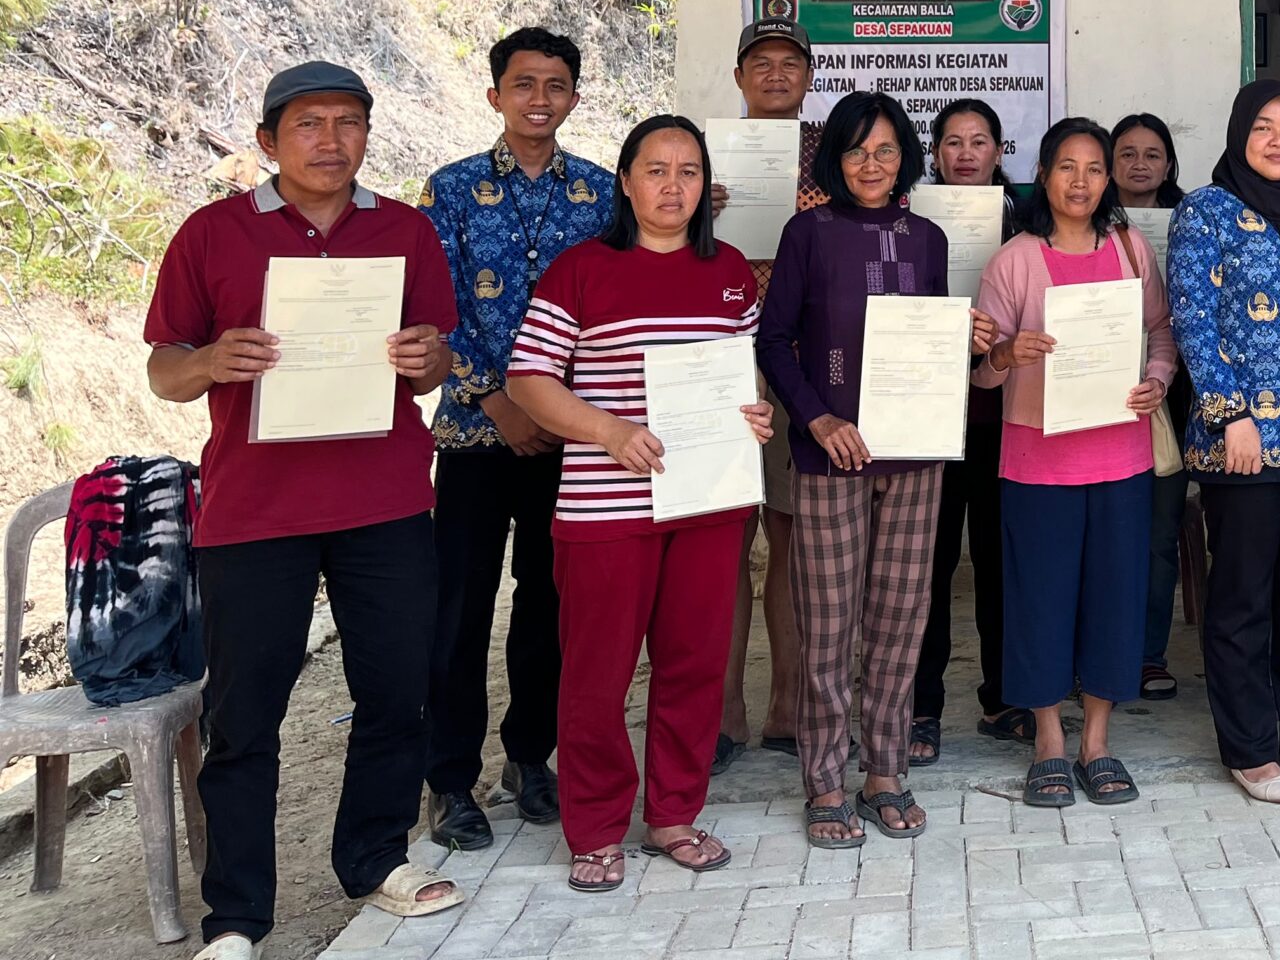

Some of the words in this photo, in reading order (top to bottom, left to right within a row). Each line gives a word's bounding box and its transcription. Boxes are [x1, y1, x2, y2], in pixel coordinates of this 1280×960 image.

[853, 4, 918, 16] KECAMATAN
[920, 4, 954, 16] BALLA
[854, 23, 887, 36] DESA
[889, 23, 952, 36] SEPAKUAN
[811, 54, 846, 70] APAN
[850, 54, 932, 69] INFORMASI
[935, 53, 1008, 69] KEGIATAN
[806, 77, 856, 93] EGIATAN
[876, 78, 912, 92] REHAP
[914, 77, 957, 92] KANTOR
[960, 77, 987, 92] DESA
[989, 76, 1044, 91] SEPAKUAN
[906, 98, 957, 113] SEPAKU
